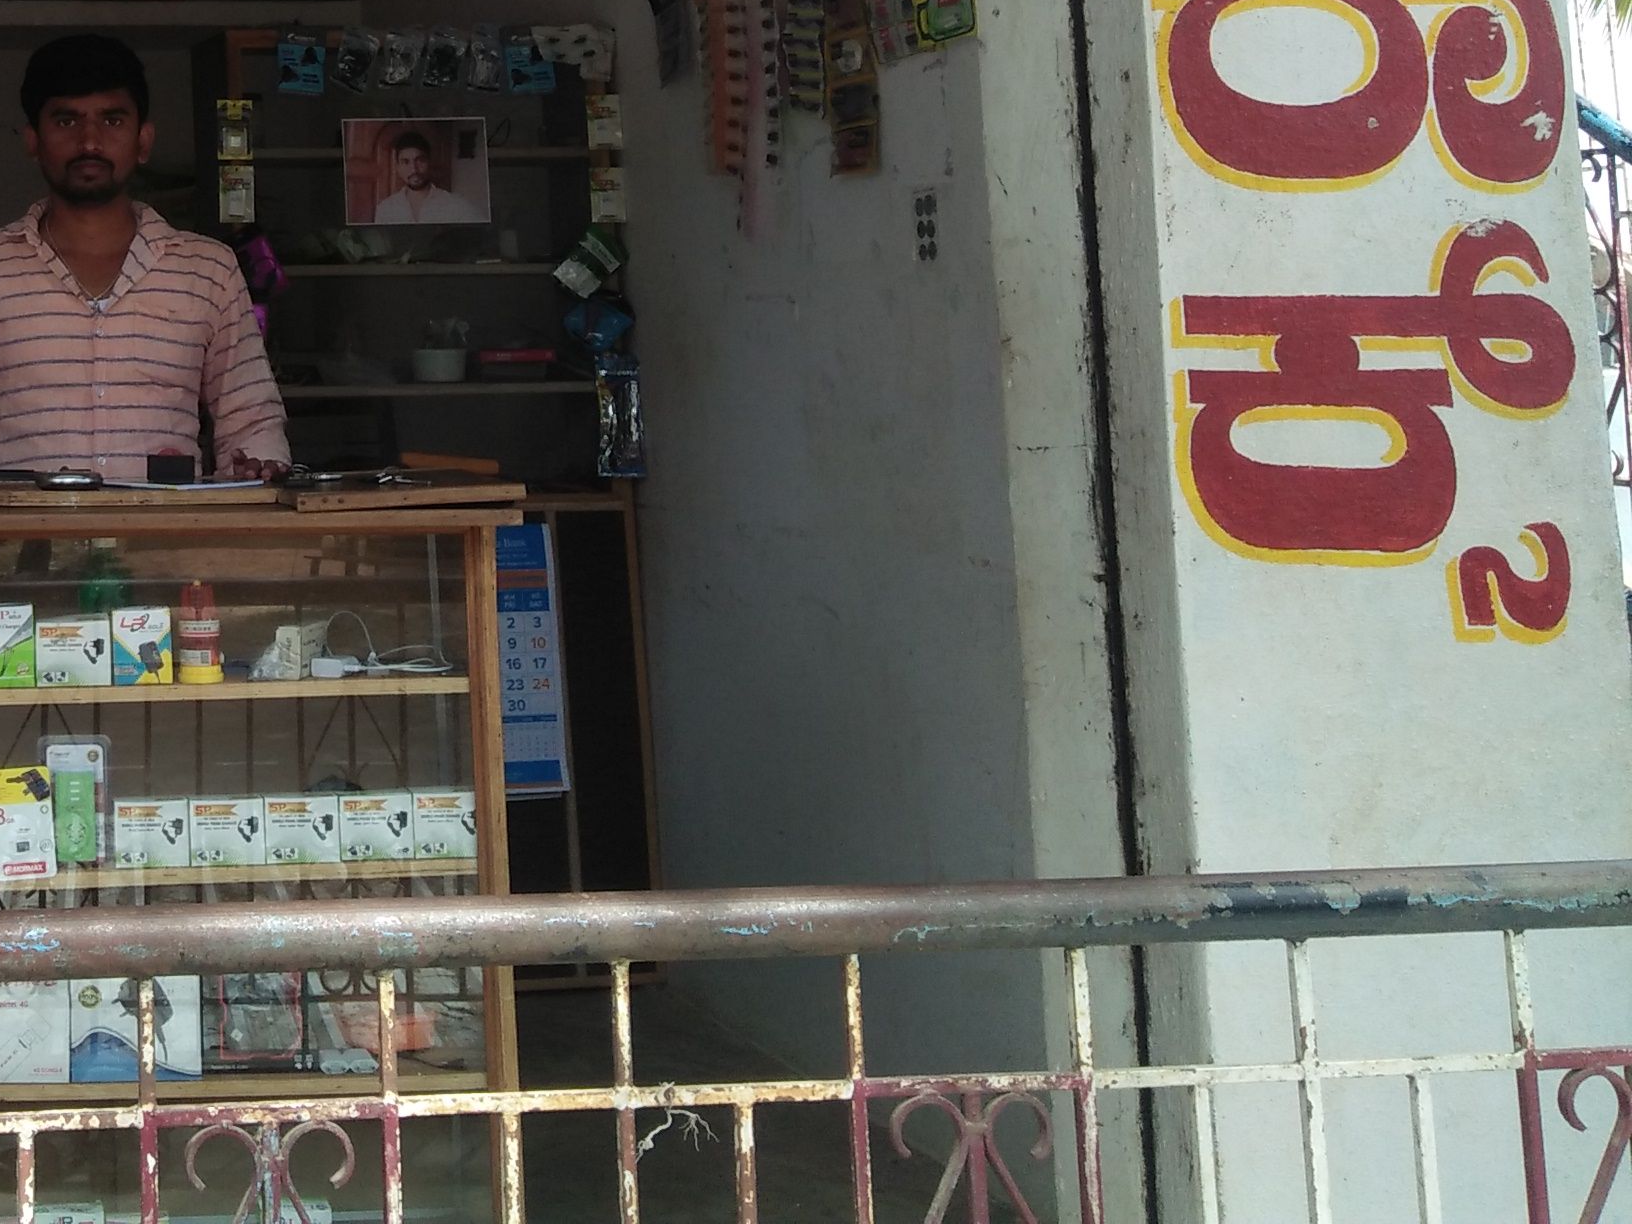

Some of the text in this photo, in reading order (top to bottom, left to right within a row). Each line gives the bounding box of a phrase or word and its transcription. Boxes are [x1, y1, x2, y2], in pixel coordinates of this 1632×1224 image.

[506, 616, 542, 629] 2 3
[507, 637, 546, 649] 9 10
[506, 657, 547, 670] 16 17
[506, 678, 550, 691] 23 24
[507, 699, 526, 712] 30
